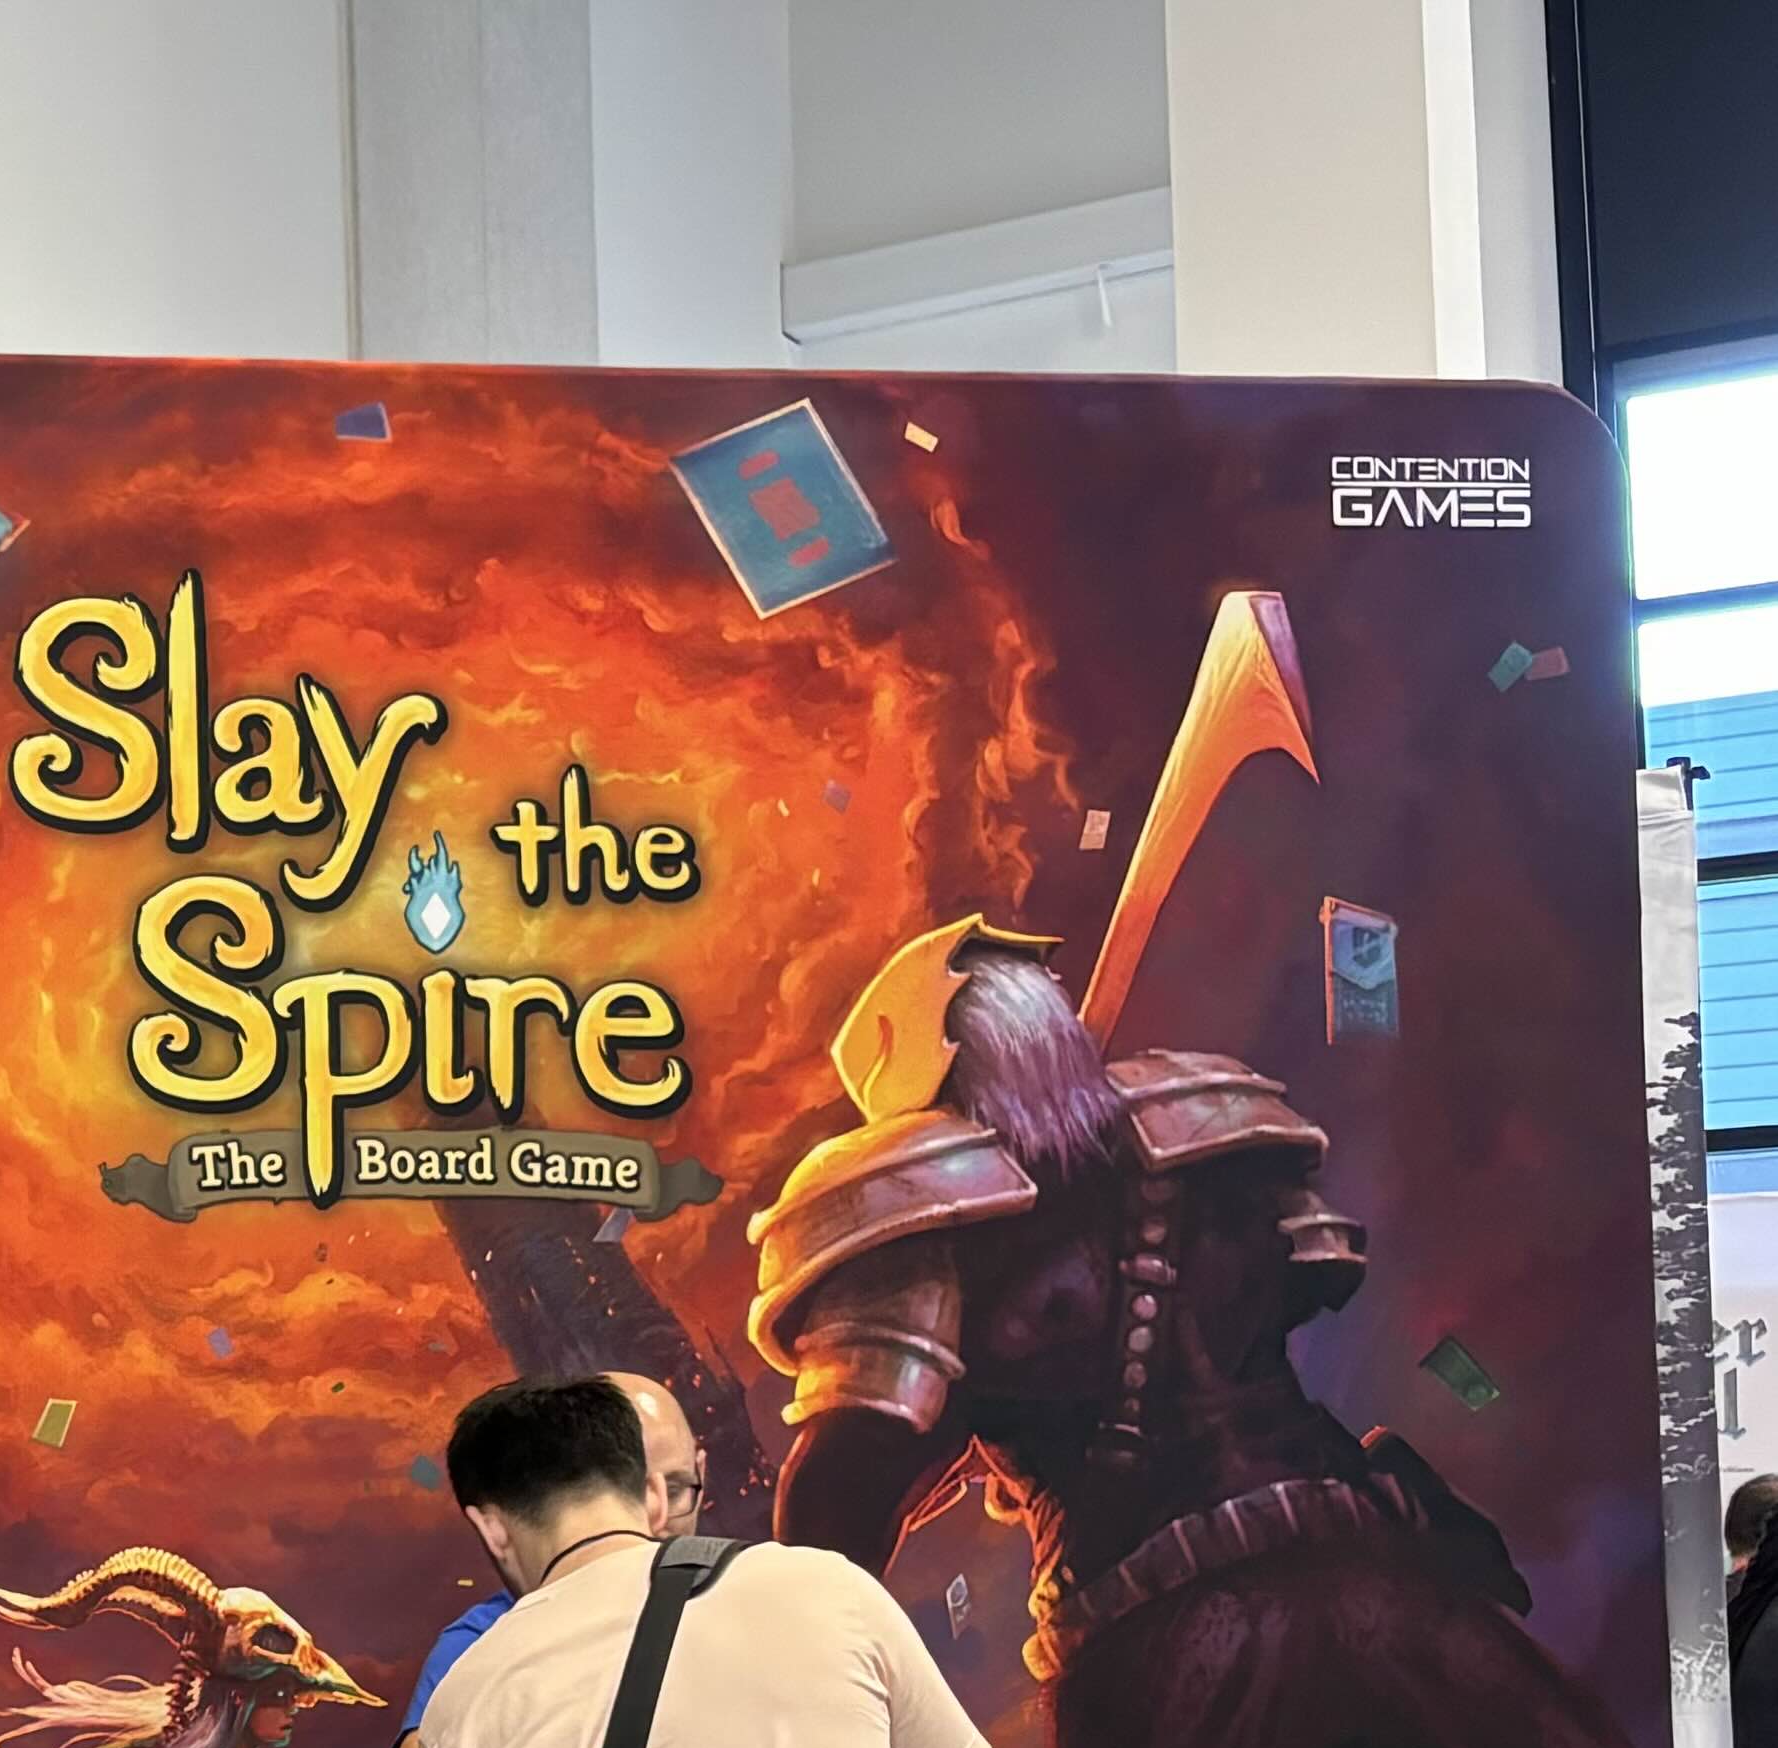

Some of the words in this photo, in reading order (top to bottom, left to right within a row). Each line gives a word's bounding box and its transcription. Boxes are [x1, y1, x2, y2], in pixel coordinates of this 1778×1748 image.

[1331, 455, 1532, 483] CONTENTION
[1332, 488, 1532, 528] GAMES
[11, 570, 444, 908] Slay
[493, 767, 697, 903] the
[130, 874, 688, 1204] Spire
[190, 1139, 285, 1192] The
[356, 1138, 495, 1185] Board
[509, 1142, 641, 1191] Game
